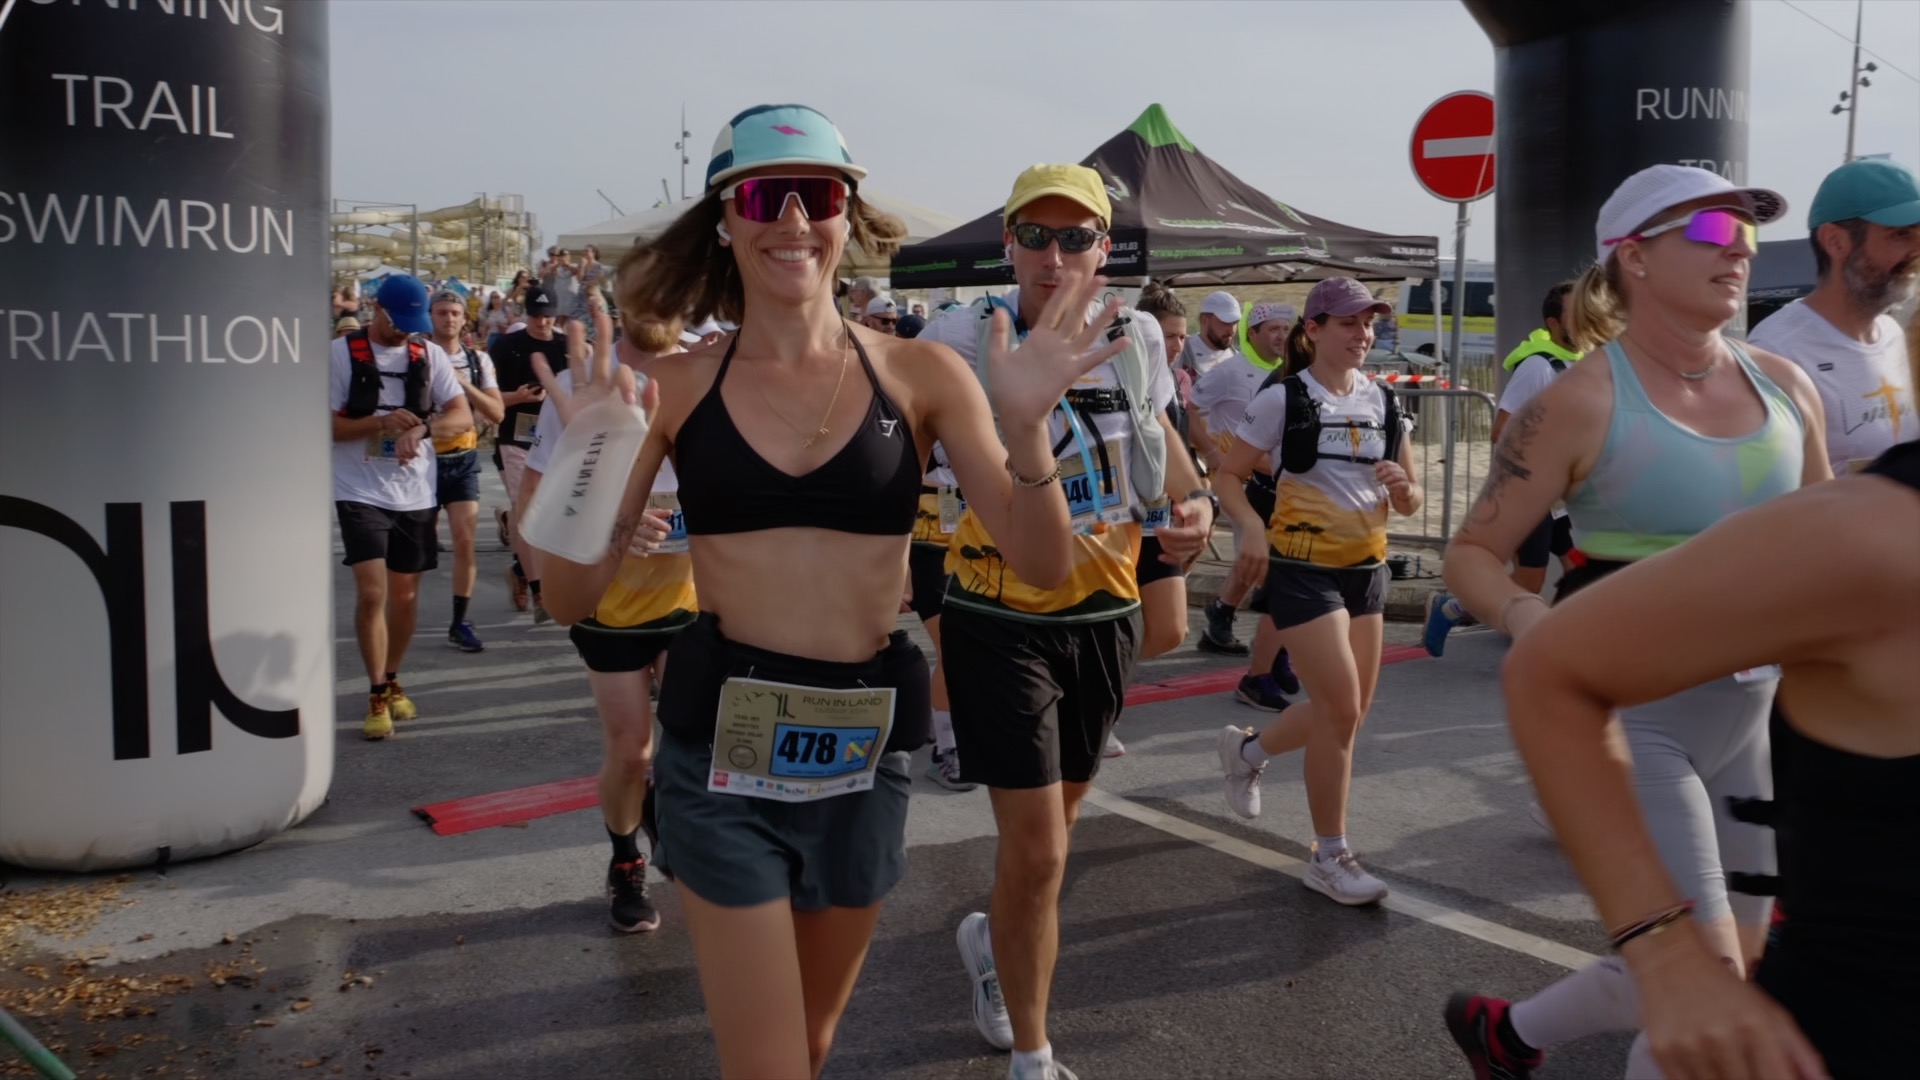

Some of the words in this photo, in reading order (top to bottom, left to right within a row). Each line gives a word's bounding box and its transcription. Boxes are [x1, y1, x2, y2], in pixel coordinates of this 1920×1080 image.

[51, 73, 235, 139] TRAIL
[1636, 87, 1750, 122] RUNNIN
[0, 309, 300, 364] RIATHLON
[802, 696, 830, 706] RUN
[833, 698, 846, 707] IN
[849, 697, 882, 707] LAND
[777, 731, 837, 765] 478
